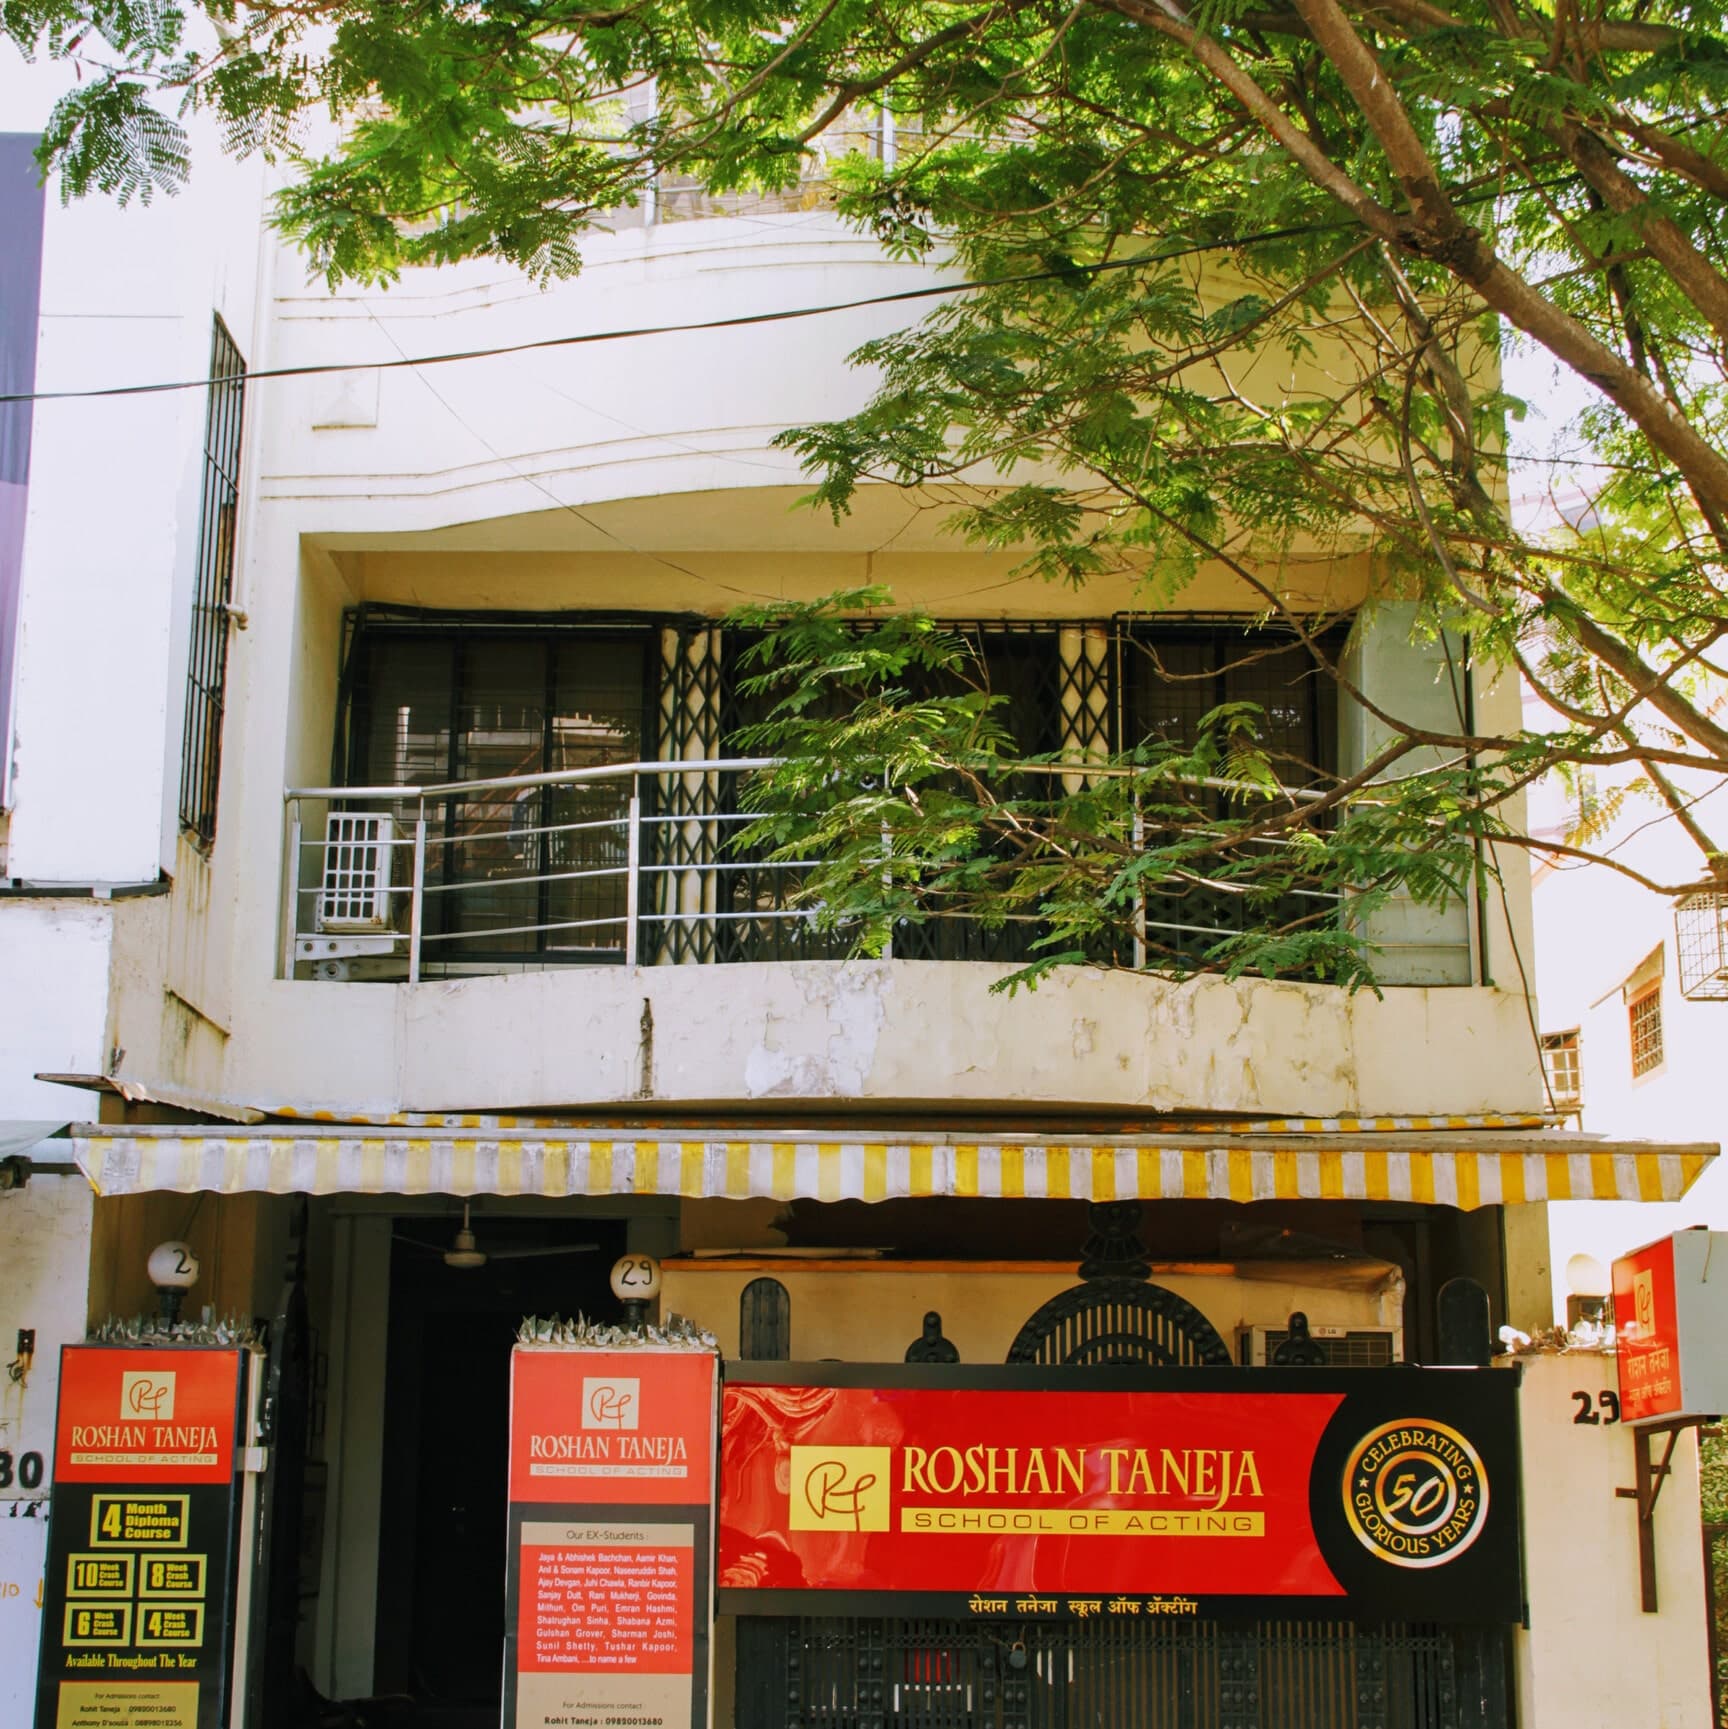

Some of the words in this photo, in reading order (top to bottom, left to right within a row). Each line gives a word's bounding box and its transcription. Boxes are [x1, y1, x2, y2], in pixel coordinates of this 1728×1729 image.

[621, 1260, 653, 1285] 29
[1571, 1390, 1620, 1425] 29
[71, 1425, 146, 1449] ROSHAN
[153, 1426, 218, 1454] TANEJA
[530, 1435, 610, 1459] ROSHAN
[616, 1437, 687, 1465] TANEJA
[1362, 1430, 1472, 1480] CELEBRATING
[76, 1454, 134, 1464] SCHOOL
[138, 1454, 156, 1463] OF
[160, 1455, 213, 1464] ACTING
[535, 1466, 598, 1475] SCHOOL
[602, 1467, 622, 1475] OF
[626, 1467, 682, 1476] ACTING
[902, 1443, 1086, 1496] ROSHAN
[1100, 1448, 1264, 1512] TANEJA
[1386, 1473, 1445, 1517] 50
[126, 1503, 167, 1514] Month
[102, 1504, 122, 1538] 4
[125, 1516, 179, 1528] Diploma
[914, 1513, 1053, 1529] SCHOOL
[1069, 1514, 1109, 1530] OF
[1125, 1516, 1252, 1532] ACTING
[1356, 1492, 1430, 1554] GLORIOUS
[1431, 1498, 1475, 1548] YEARS
[124, 1528, 172, 1538] Course
[566, 1530, 583, 1540] Our
[538, 1553, 555, 1564] Jaya
[557, 1553, 563, 1562] &
[565, 1553, 596, 1562] Abhishek
[636, 1553, 656, 1562] Aamir
[77, 1562, 98, 1587] 10
[152, 1563, 164, 1588] 8
[538, 1566, 551, 1574] Anil
[554, 1566, 558, 1574] &
[560, 1566, 584, 1574] Sonam
[166, 1572, 189, 1580] Crash
[538, 1578, 553, 1588] Ajay
[584, 1579, 598, 1587] Juhi
[628, 1579, 650, 1588] Ranbir
[538, 1590, 561, 1600] Sanjay
[589, 1591, 605, 1599] Rani
[572, 1604, 585, 1612] Om
[616, 1604, 640, 1612] Emran
[968, 1594, 1008, 1613] रोशन
[1016, 1594, 1058, 1613] तनेजा
[1068, 1600, 1102, 1617] स्कूल
[1108, 1596, 1142, 1614] ऑफ
[78, 1612, 90, 1636] 6
[148, 1612, 162, 1637] 4
[537, 1616, 581, 1626] Shatrughan
[616, 1616, 650, 1626] Shabana
[92, 1628, 118, 1636] Course
[162, 1629, 190, 1637] Course
[536, 1628, 570, 1638] Gulshan
[612, 1630, 648, 1638] Sharman
[536, 1642, 560, 1650] Sunil
[604, 1642, 636, 1650] Tushar
[66, 1654, 105, 1668] Available
[107, 1654, 157, 1670] Throughout
[160, 1654, 176, 1668] The
[178, 1654, 198, 1668] Year
[536, 1654, 551, 1662] Tina
[598, 1656, 616, 1664] name
[618, 1656, 622, 1664] a
[624, 1654, 636, 1664] few
[100, 1706, 120, 1714] Taneja
[616, 1702, 642, 1710] contact
[544, 1716, 568, 1724] Rohit
[571, 1717, 598, 1726] Taneja
